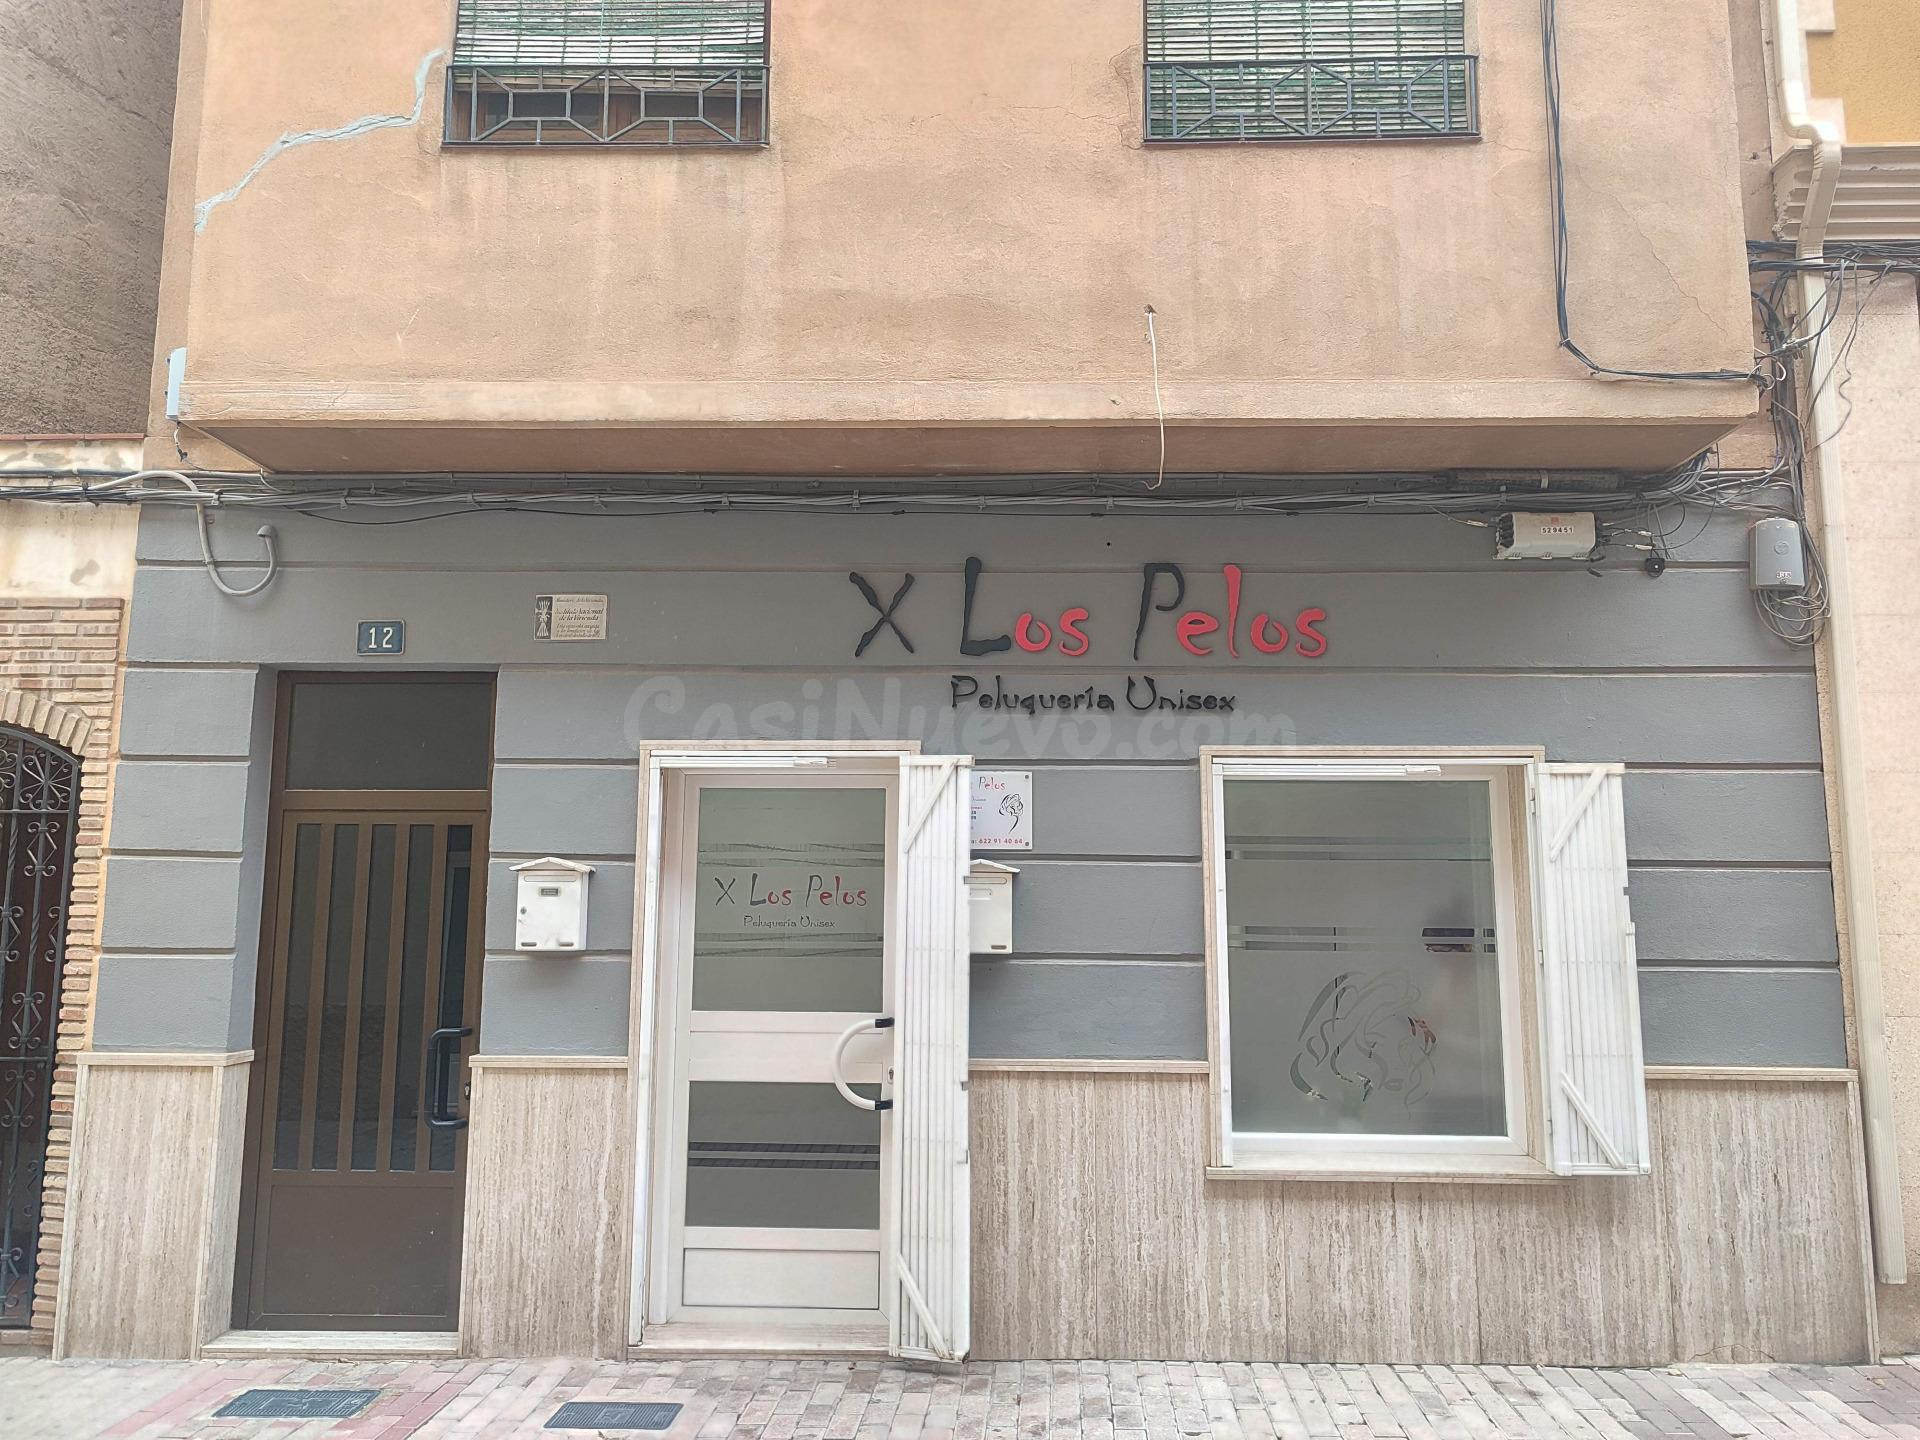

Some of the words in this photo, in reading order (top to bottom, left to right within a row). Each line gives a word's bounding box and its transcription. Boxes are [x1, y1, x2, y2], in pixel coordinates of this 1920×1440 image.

[1541, 526, 1574, 534] 529451
[848, 570, 916, 658] X
[960, 556, 1090, 657] Los
[1133, 562, 1329, 661] Pelos
[367, 626, 393, 649] 12
[950, 674, 1116, 716] Peluquería
[1126, 675, 1238, 712] Unisex
[978, 776, 1006, 790] Pelos
[714, 877, 736, 906] X
[750, 872, 792, 907] Los
[805, 874, 867, 907] Pelos
[743, 915, 797, 928] Peluquería
[800, 915, 836, 928] Unisex
